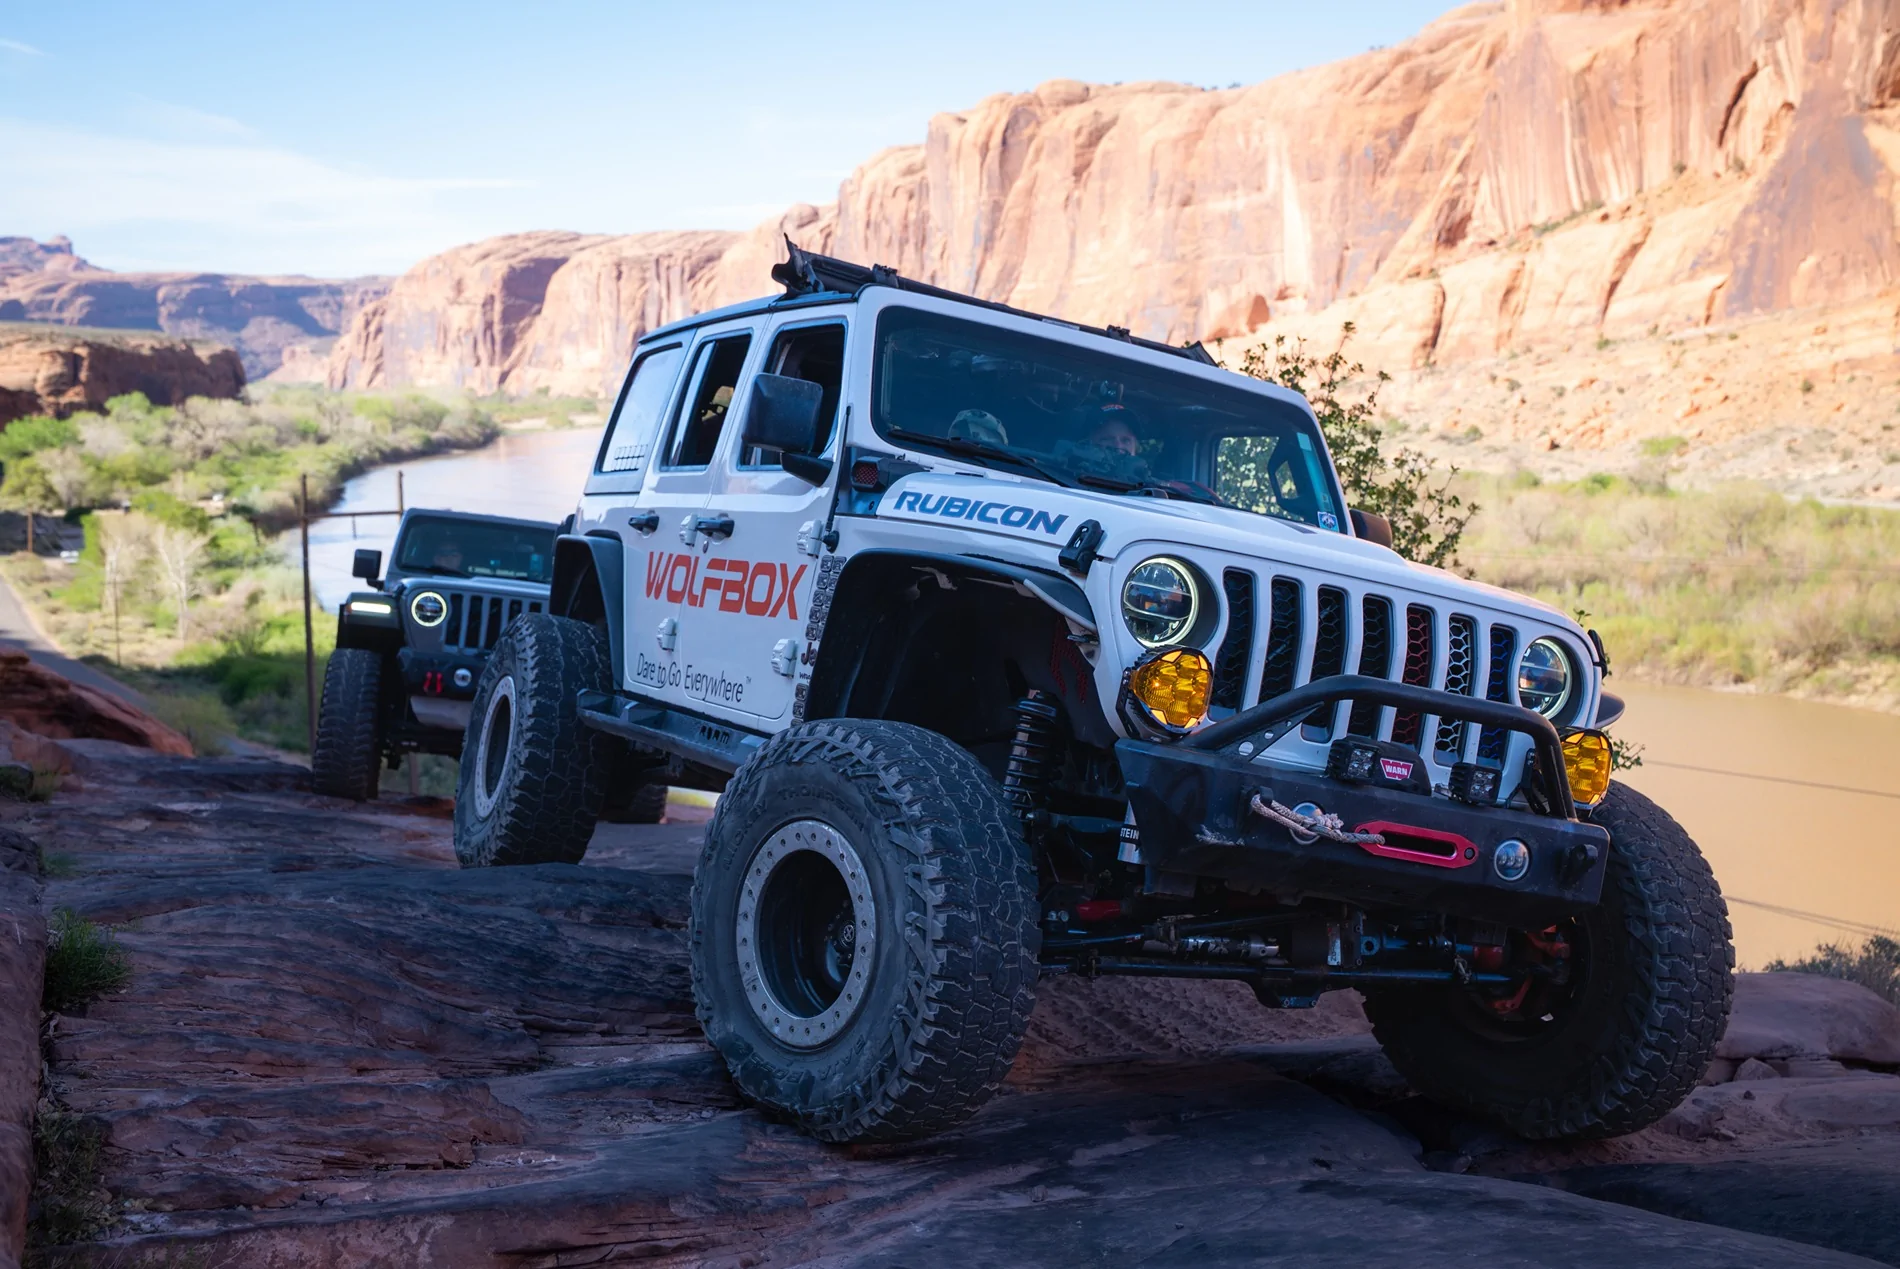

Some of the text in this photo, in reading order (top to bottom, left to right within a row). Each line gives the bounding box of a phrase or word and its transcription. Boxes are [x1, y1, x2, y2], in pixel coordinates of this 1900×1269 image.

[894, 490, 1069, 535] RUBICON
[645, 551, 808, 620] WOLFBOX
[637, 653, 655, 681] Dare
[658, 661, 666, 684] to
[669, 661, 681, 687] Go
[684, 665, 743, 702] Everywhere
[1384, 764, 1408, 776] WARN
